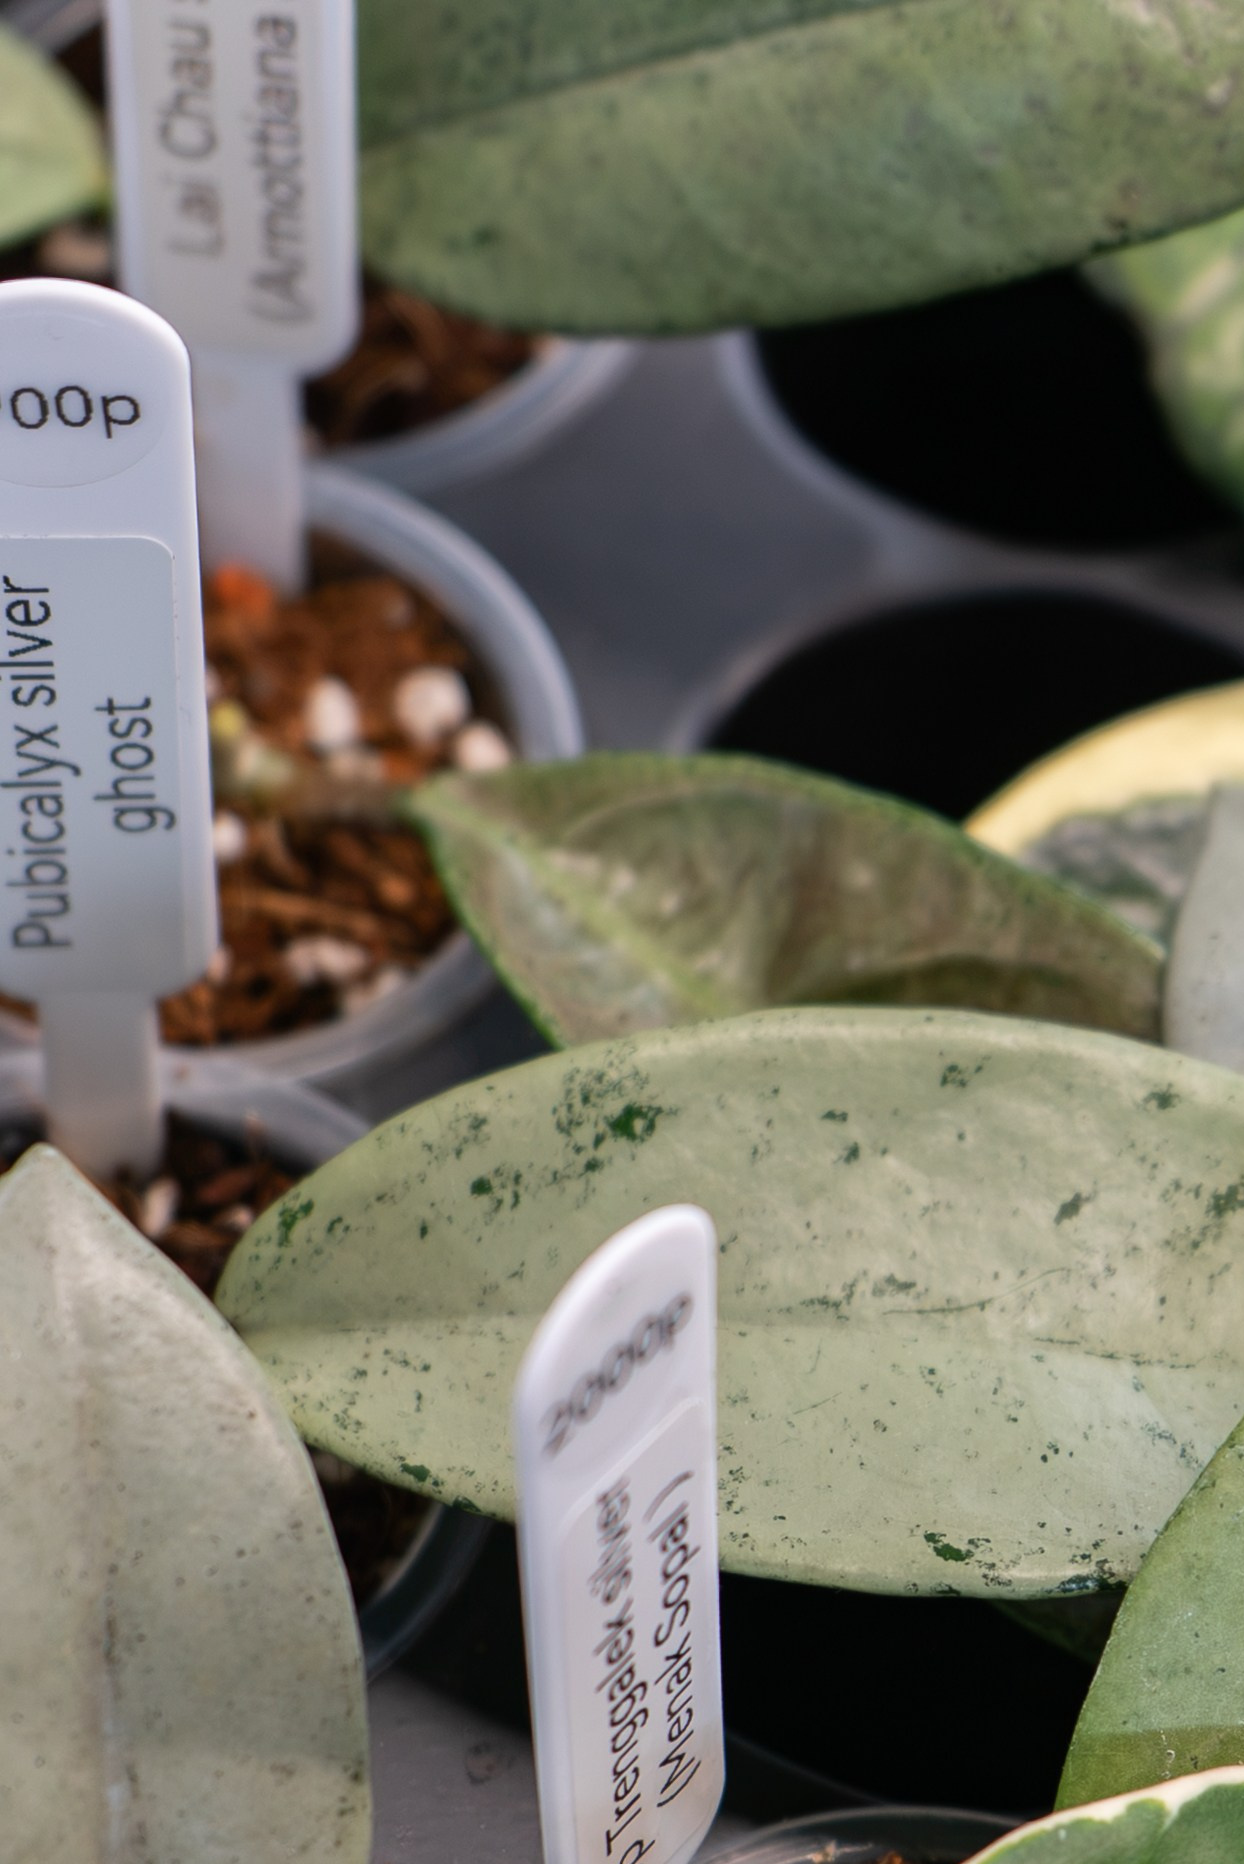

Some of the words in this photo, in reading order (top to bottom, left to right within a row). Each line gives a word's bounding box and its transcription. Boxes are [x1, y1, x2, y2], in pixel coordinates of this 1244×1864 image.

[156, 16, 218, 166] Chau
[0, 384, 141, 440] 00p
[0, 574, 57, 707] silver
[0, 723, 82, 949] Pubicalyx
[93, 696, 177, 833] ghost
[588, 1476, 633, 1606] silver
[647, 1502, 701, 1648] Sopal
[593, 1598, 649, 1857] Trenggalek
[654, 1631, 701, 1808] (Menak
